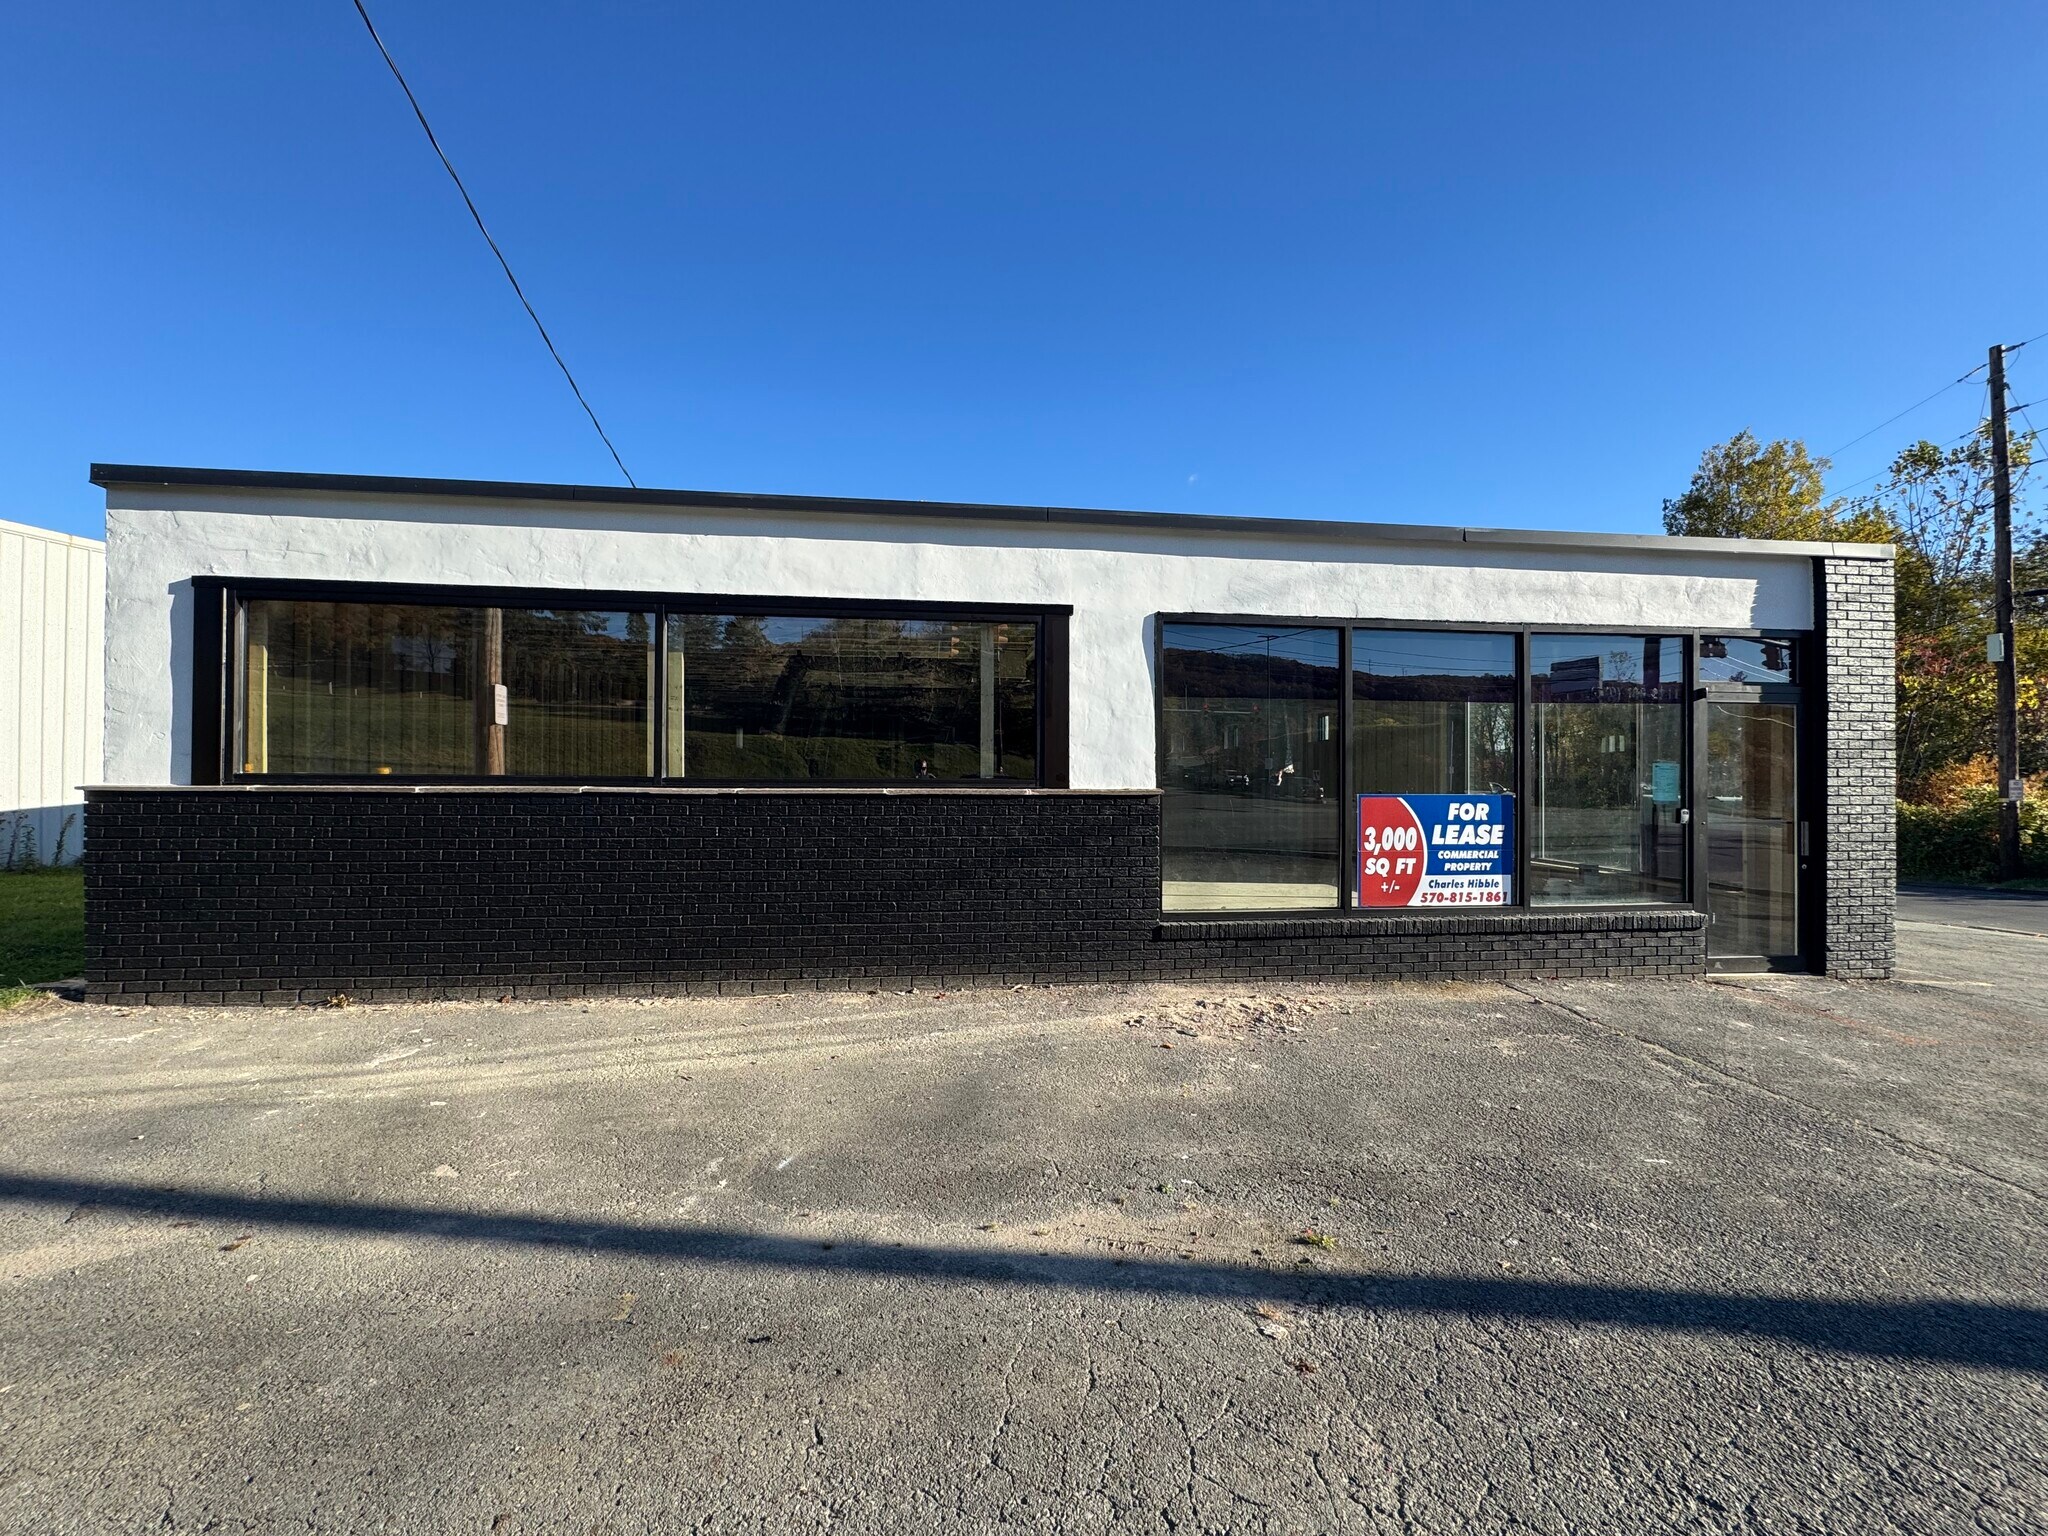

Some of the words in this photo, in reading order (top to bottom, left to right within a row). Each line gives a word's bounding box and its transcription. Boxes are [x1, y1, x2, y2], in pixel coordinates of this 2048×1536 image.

[1448, 802, 1490, 821] FOR
[1363, 826, 1417, 855] 3,000
[1432, 824, 1505, 845] LEASE
[1438, 850, 1499, 859] COMMERCIAL
[1364, 857, 1390, 877] SQ
[1395, 858, 1416, 875] FT
[1444, 862, 1492, 871] PROPERTY
[1381, 880, 1400, 894] +/-
[1428, 879, 1464, 889] Charles
[1467, 879, 1500, 889] Hibble
[1420, 891, 1508, 903] 570-815-1861
